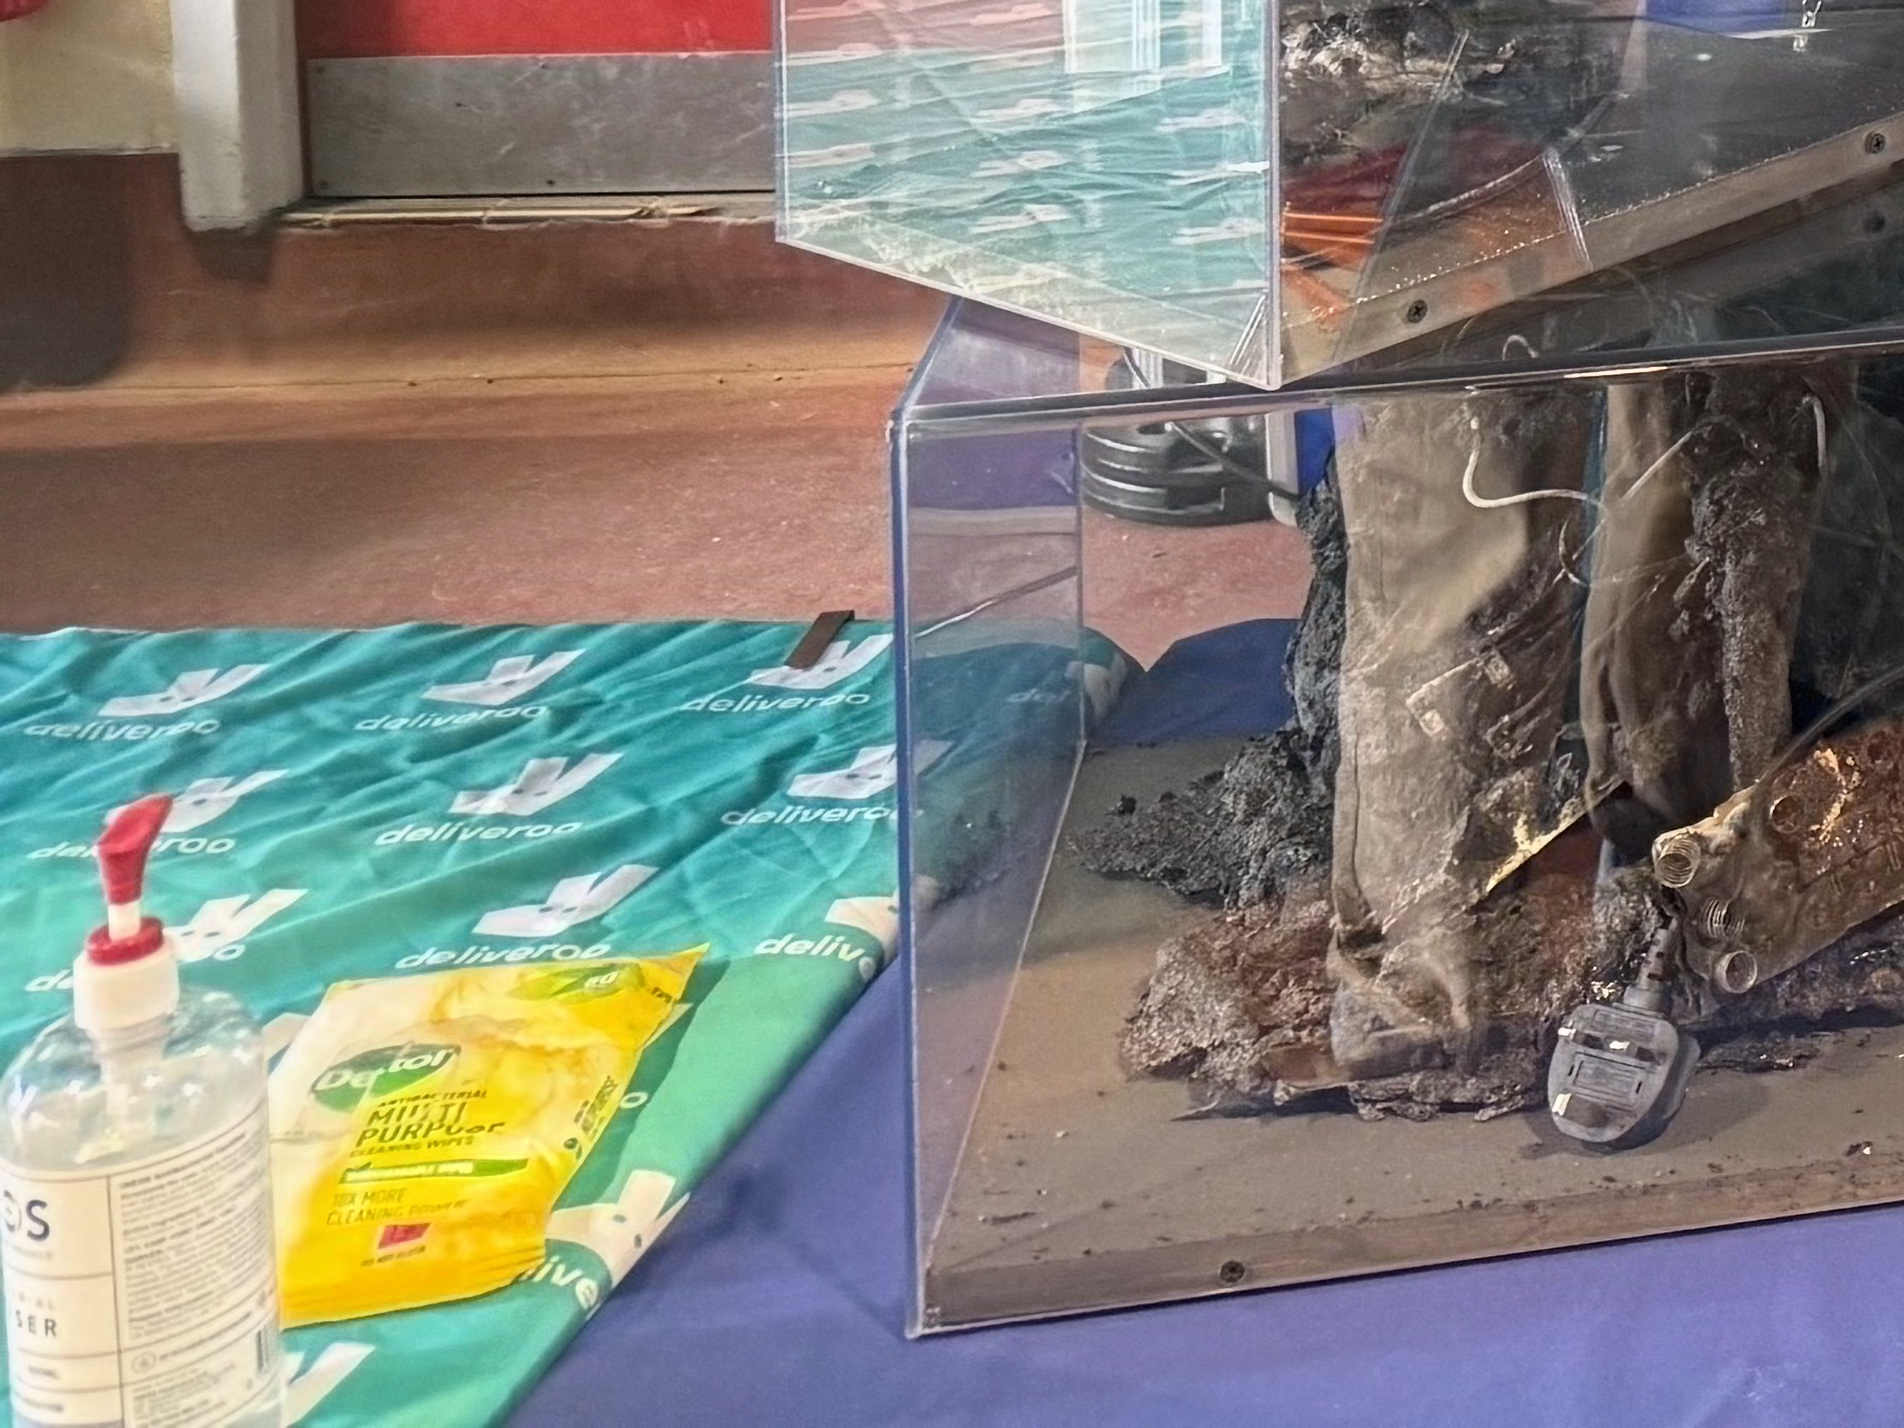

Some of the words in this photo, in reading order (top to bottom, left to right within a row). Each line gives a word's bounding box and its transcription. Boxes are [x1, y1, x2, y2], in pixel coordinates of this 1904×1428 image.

[682, 691, 872, 714] deliveroo
[25, 718, 221, 743] deliveroo
[355, 703, 548, 734] deliveroo
[374, 817, 583, 848] deliveroo
[396, 942, 612, 970] deliveroo
[350, 1141, 424, 1158] CLEANING
[362, 1187, 407, 1206] MORE
[327, 1205, 404, 1226] CLEANING
